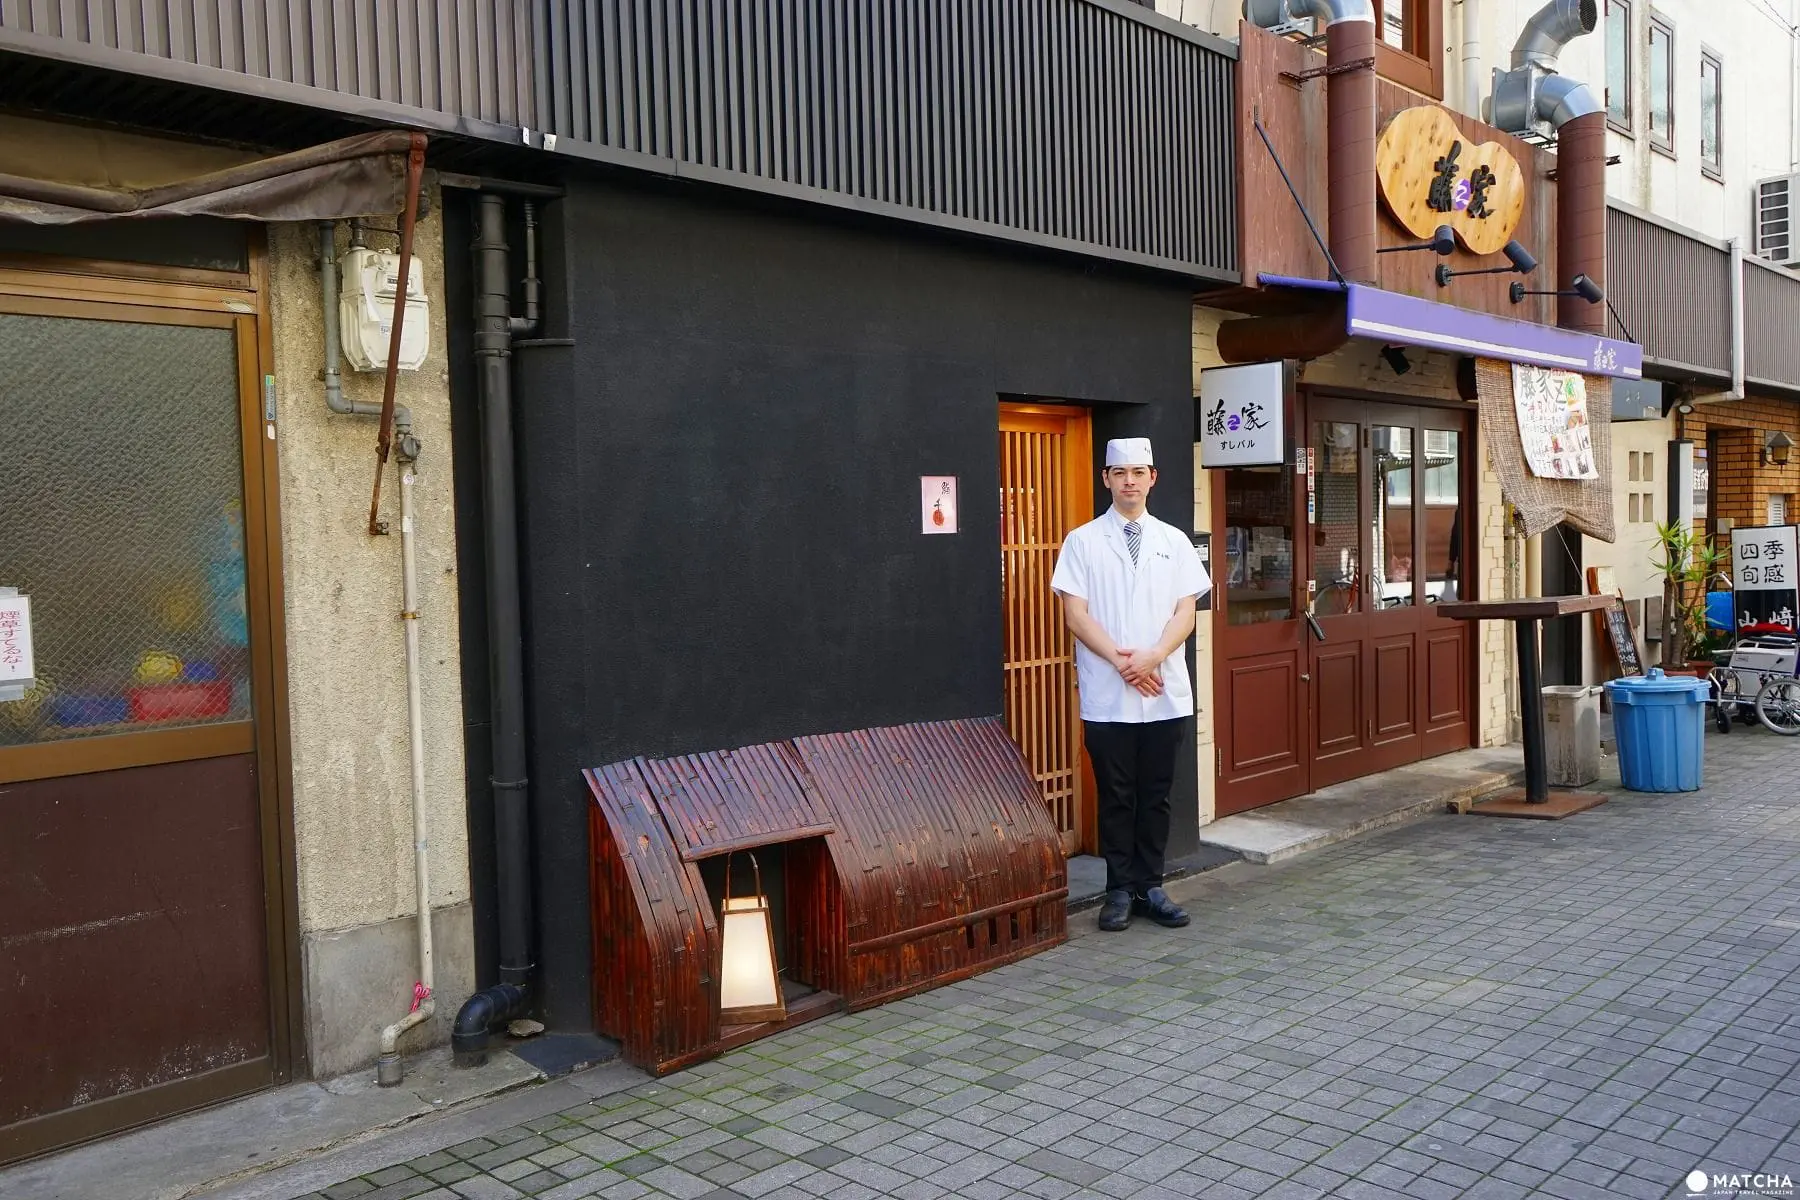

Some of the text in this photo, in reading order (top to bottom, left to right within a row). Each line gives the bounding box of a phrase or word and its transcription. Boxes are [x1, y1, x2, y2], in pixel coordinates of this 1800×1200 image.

[1220, 439, 1256, 451] すしバル
[1740, 540, 1784, 560] 四季
